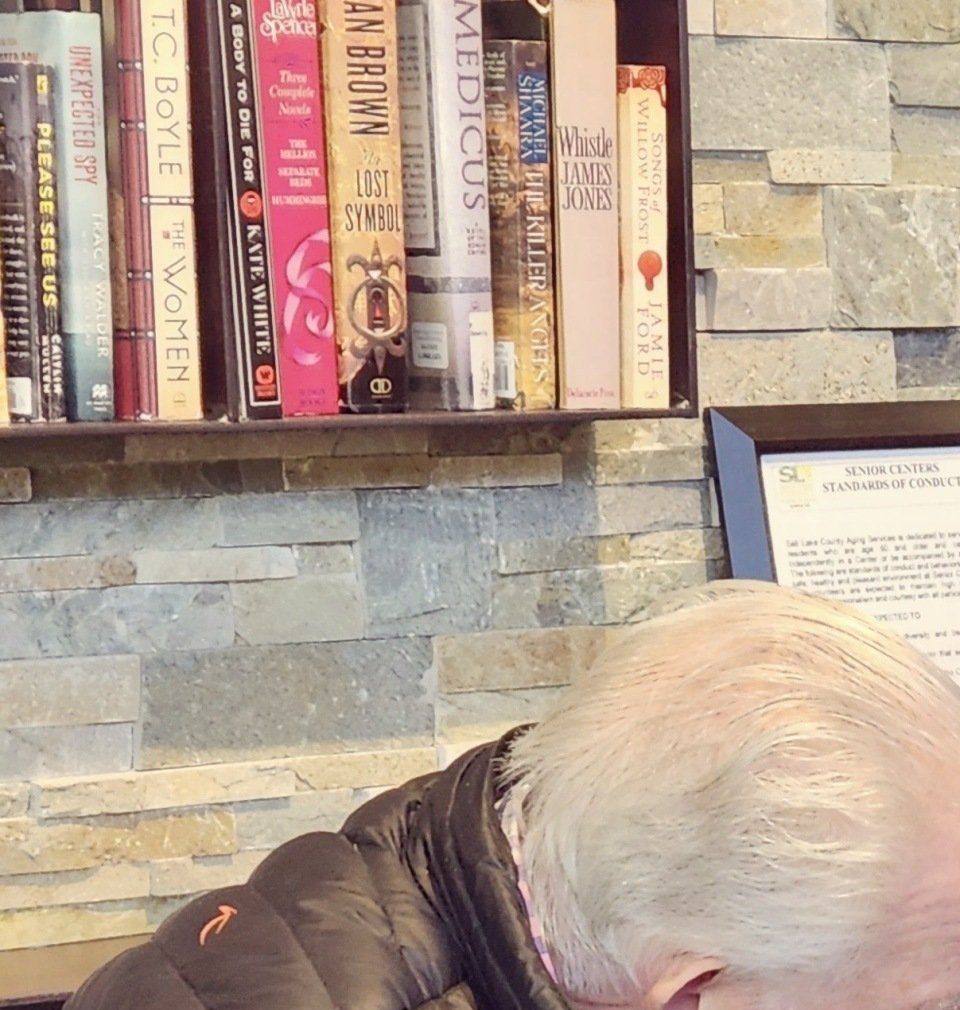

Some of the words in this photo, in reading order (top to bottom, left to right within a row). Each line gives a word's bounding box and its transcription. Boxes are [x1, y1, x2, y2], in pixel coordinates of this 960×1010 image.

[229, 3, 242, 18] A
[151, 9, 178, 64] T.C.
[231, 24, 246, 75] BODY
[68, 45, 96, 151] UNEXPECTED
[237, 77, 248, 103] TO
[269, 85, 315, 100] Complete
[279, 69, 307, 84] Three
[346, 44, 389, 136] BROWN
[154, 76, 183, 176] BOYLE
[238, 107, 251, 140] DIE
[278, 102, 312, 116] Novels
[454, 0, 486, 211] MEDICUS
[517, 75, 533, 161] SHAARA
[534, 78, 547, 161] MICHAEL
[241, 145, 254, 182] FOR
[288, 139, 307, 149] THE
[557, 127, 613, 159] Whistle
[637, 98, 649, 180] WILLOW
[651, 132, 663, 196] SONGS
[37, 123, 55, 215] PLEASE
[74, 152, 98, 187] SPY
[356, 169, 389, 198] LOST
[525, 169, 544, 212] THE
[560, 162, 612, 186] JAMES
[344, 203, 401, 232] SYMBOL
[562, 187, 612, 211] JONES
[638, 186, 650, 244] FROST
[40, 221, 56, 268] SEE
[91, 213, 106, 272] TRACY
[171, 221, 186, 250] THE
[246, 224, 265, 281] KATE
[525, 215, 548, 292] KILLER
[42, 275, 58, 308] US
[95, 282, 109, 358] WALDER
[162, 255, 190, 383] WOMEN
[251, 283, 272, 356] WHITE
[527, 296, 551, 383] ANGELS
[637, 306, 650, 377] FORD
[648, 301, 664, 381] JAMIE
[822, 480, 890, 494] STANDARDS
[892, 478, 906, 491] OF
[844, 465, 887, 478] SENIOR
[889, 463, 940, 475] CENTERS
